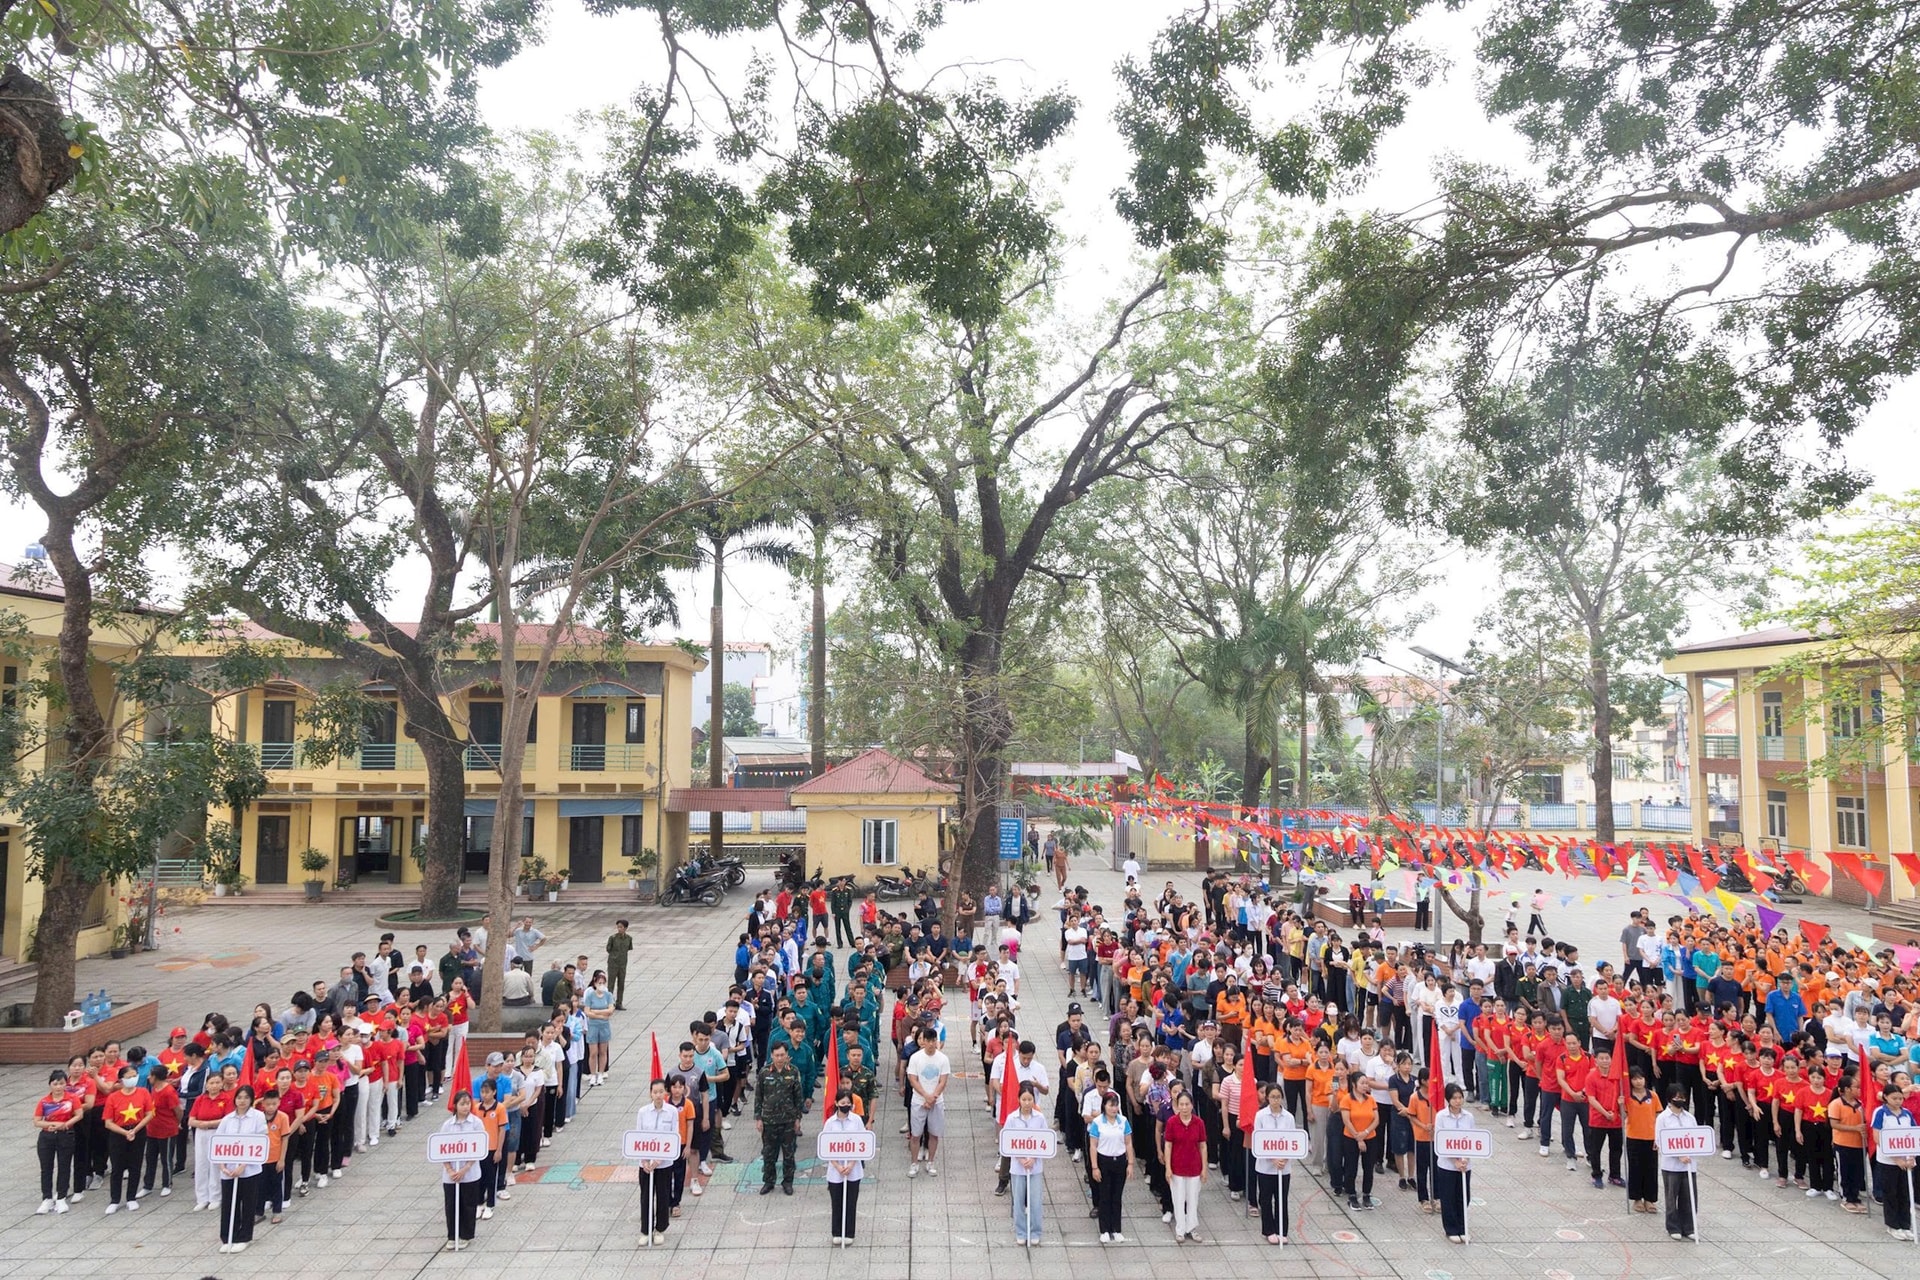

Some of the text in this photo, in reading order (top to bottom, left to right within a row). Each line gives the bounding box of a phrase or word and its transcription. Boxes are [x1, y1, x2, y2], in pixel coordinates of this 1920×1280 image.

[214, 1140, 263, 1157] KHỐI 12
[439, 1139, 477, 1154] KHỐI 1
[633, 1138, 671, 1153] KHỐI 2
[828, 1139, 866, 1153] KHỐI 3
[1010, 1136, 1047, 1151] KHỐI 4
[1262, 1137, 1299, 1151] KHỐI 5
[1445, 1136, 1483, 1151] KHỐI 6
[1667, 1133, 1705, 1149] KHỐI 7
[1888, 1133, 1916, 1149] KHỐI
